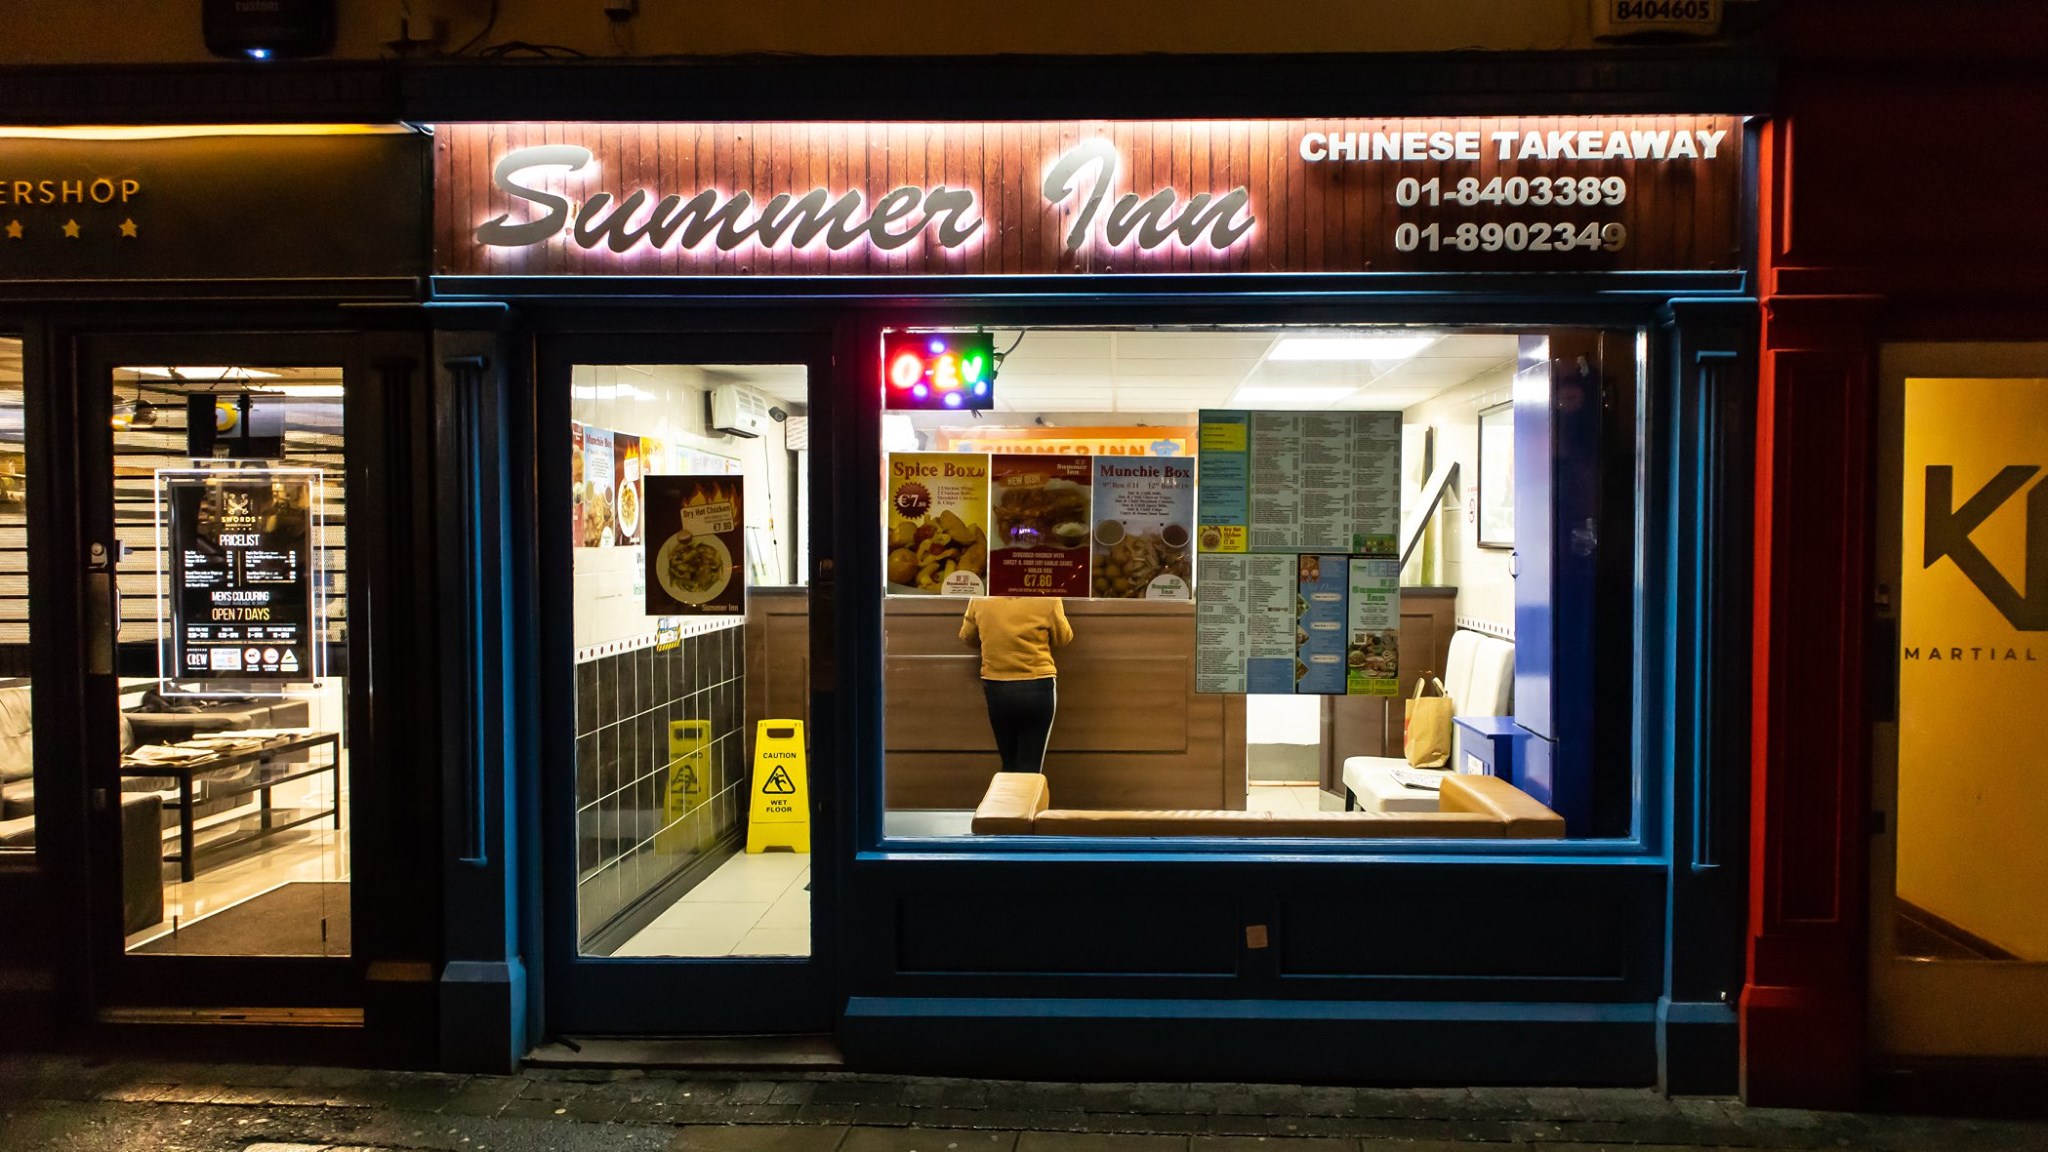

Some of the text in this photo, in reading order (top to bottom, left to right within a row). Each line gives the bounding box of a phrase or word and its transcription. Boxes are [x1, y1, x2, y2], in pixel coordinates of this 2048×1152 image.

[1617, 1, 1710, 20] 8404605
[1299, 130, 1727, 161] CHINESE TAKEAWAY
[476, 138, 1257, 252] Summer Inn
[1396, 176, 1627, 207] 01-8403389
[1395, 222, 1627, 252] 01-8902349
[894, 461, 938, 480] Spice
[1100, 464, 1190, 478] Munchie Box
[682, 510, 694, 519] Dry
[695, 508, 706, 516] Hot
[706, 505, 731, 514] Chicken
[219, 534, 260, 546] PRICELIST
[212, 607, 270, 621] OPEN 7 DAYS
[702, 603, 739, 612] Summer Inn
[187, 653, 208, 666] CREW
[1904, 647, 2037, 661] MARTIAL
